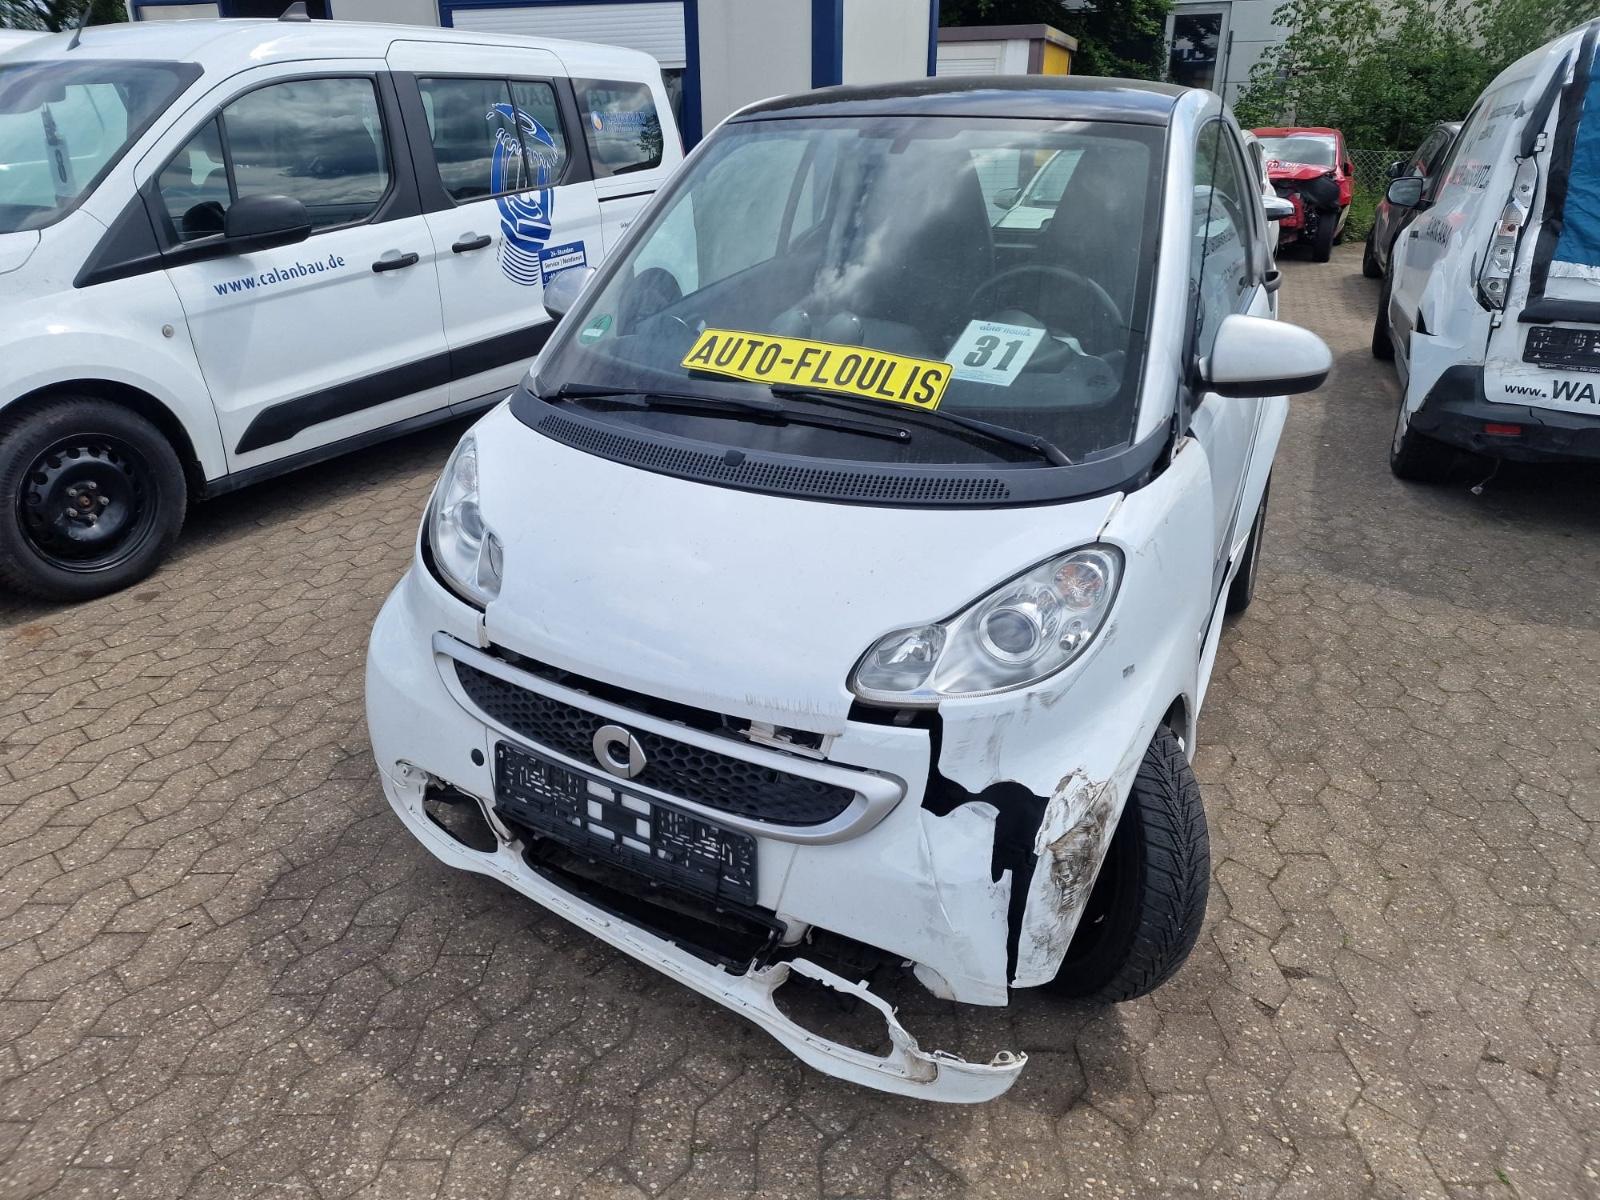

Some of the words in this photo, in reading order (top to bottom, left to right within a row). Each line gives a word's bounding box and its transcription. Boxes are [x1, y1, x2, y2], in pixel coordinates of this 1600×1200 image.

[213, 254, 346, 296] www.calanbau.de
[544, 260, 560, 269] Service
[688, 335, 943, 404] AUTO-FLOULIS
[963, 335, 1024, 372] 31
[1505, 380, 1600, 404] www.WA
